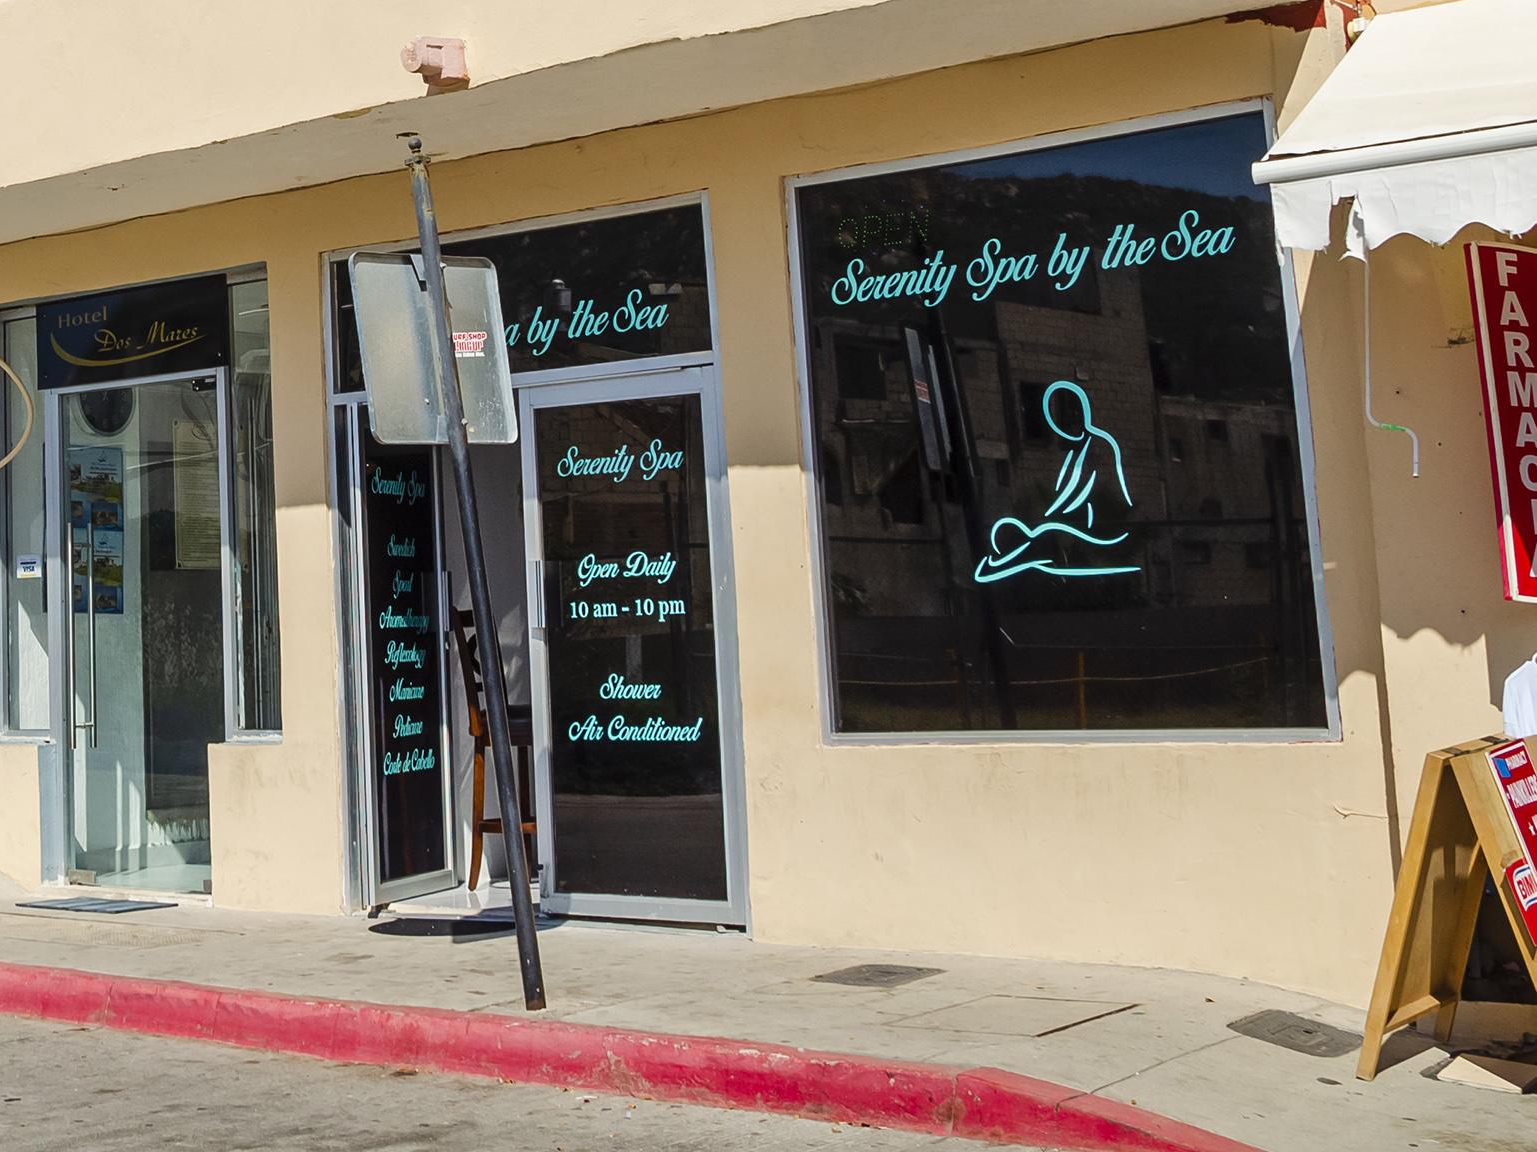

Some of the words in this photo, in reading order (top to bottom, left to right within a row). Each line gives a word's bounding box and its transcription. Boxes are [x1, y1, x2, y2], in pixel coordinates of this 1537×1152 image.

[838, 208, 930, 249] OPEN
[830, 248, 958, 308] Serenity
[965, 237, 1040, 302] Spa
[1046, 232, 1091, 292] by
[1100, 222, 1157, 271] the
[1160, 208, 1236, 262] Sea
[57, 305, 108, 329] Hotel
[526, 305, 561, 357] by
[567, 298, 611, 340] the
[612, 287, 671, 333] Sea
[94, 328, 132, 352] Dos
[136, 320, 199, 350] Mares
[452, 332, 467, 341] URF
[1495, 250, 1537, 578] FARMAC
[556, 445, 636, 483] Serenity
[639, 437, 685, 482] Spa
[371, 466, 406, 505] Serenity
[407, 469, 426, 506] Spa
[387, 533, 416, 558] Swedish
[577, 553, 621, 588] Open
[623, 550, 677, 585] Daily
[570, 601, 589, 619] 10
[593, 601, 618, 618] am
[635, 598, 655, 616] 10
[658, 598, 686, 623] pm
[384, 639, 428, 671] Reflexology
[389, 677, 425, 702] Manicure
[599, 672, 662, 700] Shower
[392, 713, 424, 739] Pedicure
[568, 714, 604, 742] Air
[607, 714, 703, 742] Conditioned
[383, 751, 402, 776] Corte
[402, 751, 411, 773] de
[411, 748, 436, 772] Cabello
